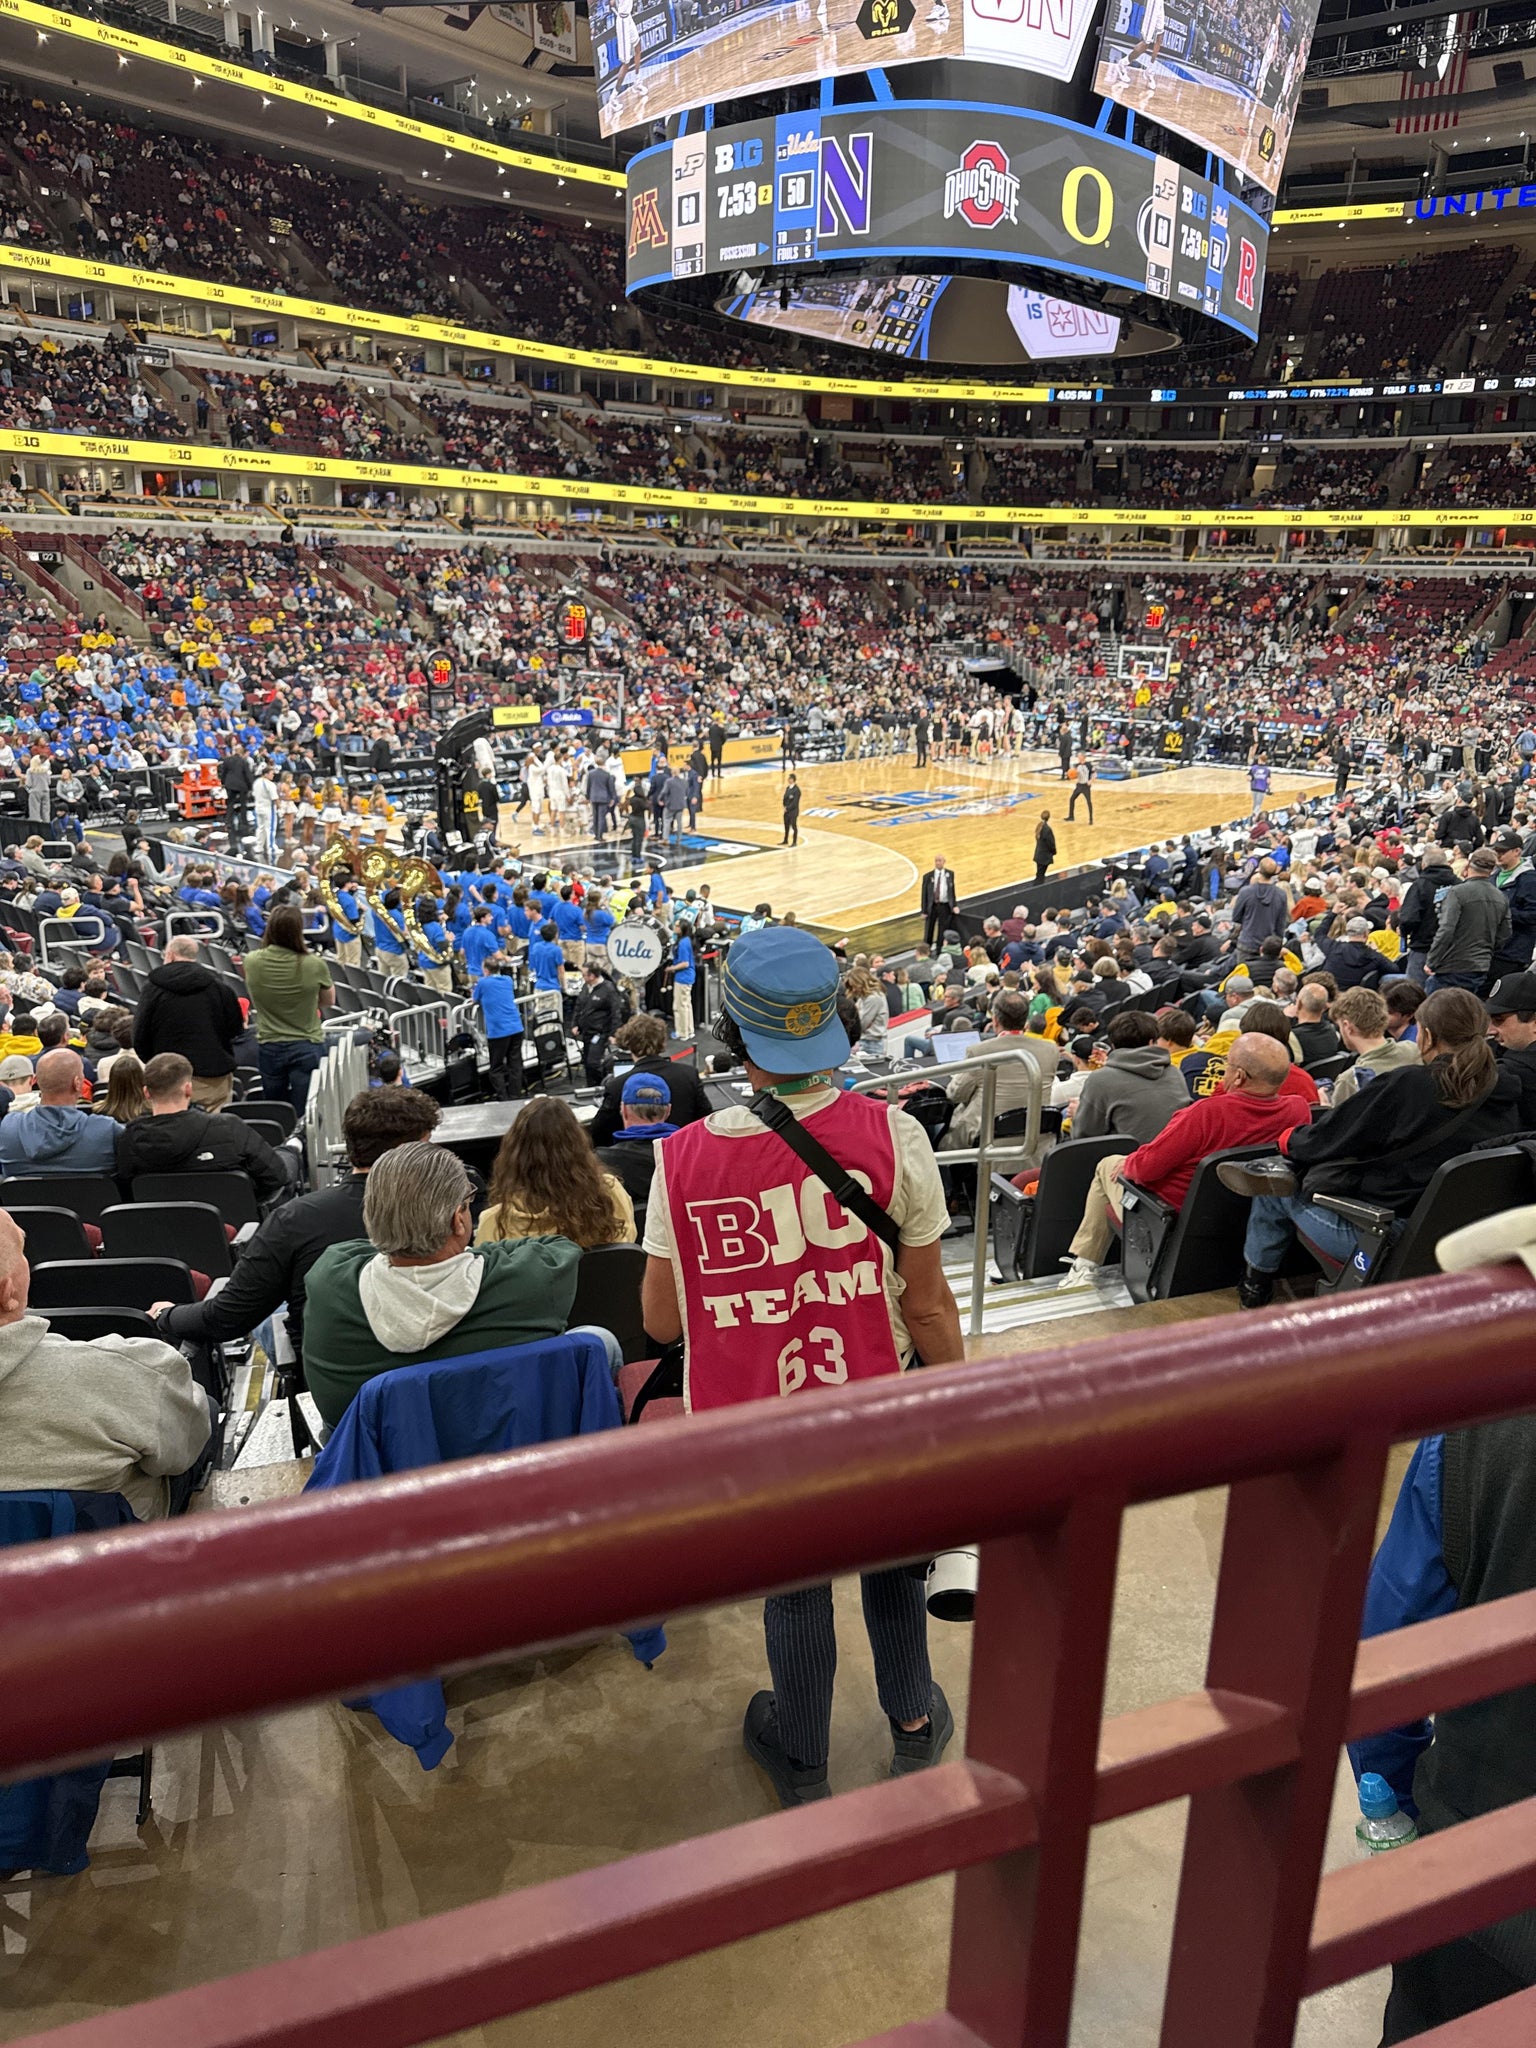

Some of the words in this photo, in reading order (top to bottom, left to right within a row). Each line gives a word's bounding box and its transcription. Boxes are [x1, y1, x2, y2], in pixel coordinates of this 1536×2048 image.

[871, 25, 901, 37] RAM
[787, 176, 806, 206] 50
[817, 132, 873, 238] N
[944, 168, 979, 219] OHIO
[979, 163, 1021, 226] STATE
[717, 181, 757, 219] 7:53
[1061, 165, 1114, 246] O
[628, 188, 668, 258] M
[805, 228, 812, 242] 3
[777, 246, 799, 262] FOULS
[805, 246, 812, 259] 5
[1235, 236, 1258, 312] R
[1026, 302, 1043, 320] IS
[1434, 382, 1442, 392] 3
[1483, 378, 1499, 390] 60
[112, 443, 130, 456] RAM
[564, 616, 585, 641] 30
[1145, 613, 1163, 628] 30
[433, 670, 449, 684] 30
[615, 938, 653, 959] Ucla
[794, 1003, 819, 1015] UCLA
[701, 1260, 882, 1330] TEAM
[776, 1325, 849, 1399] 63
